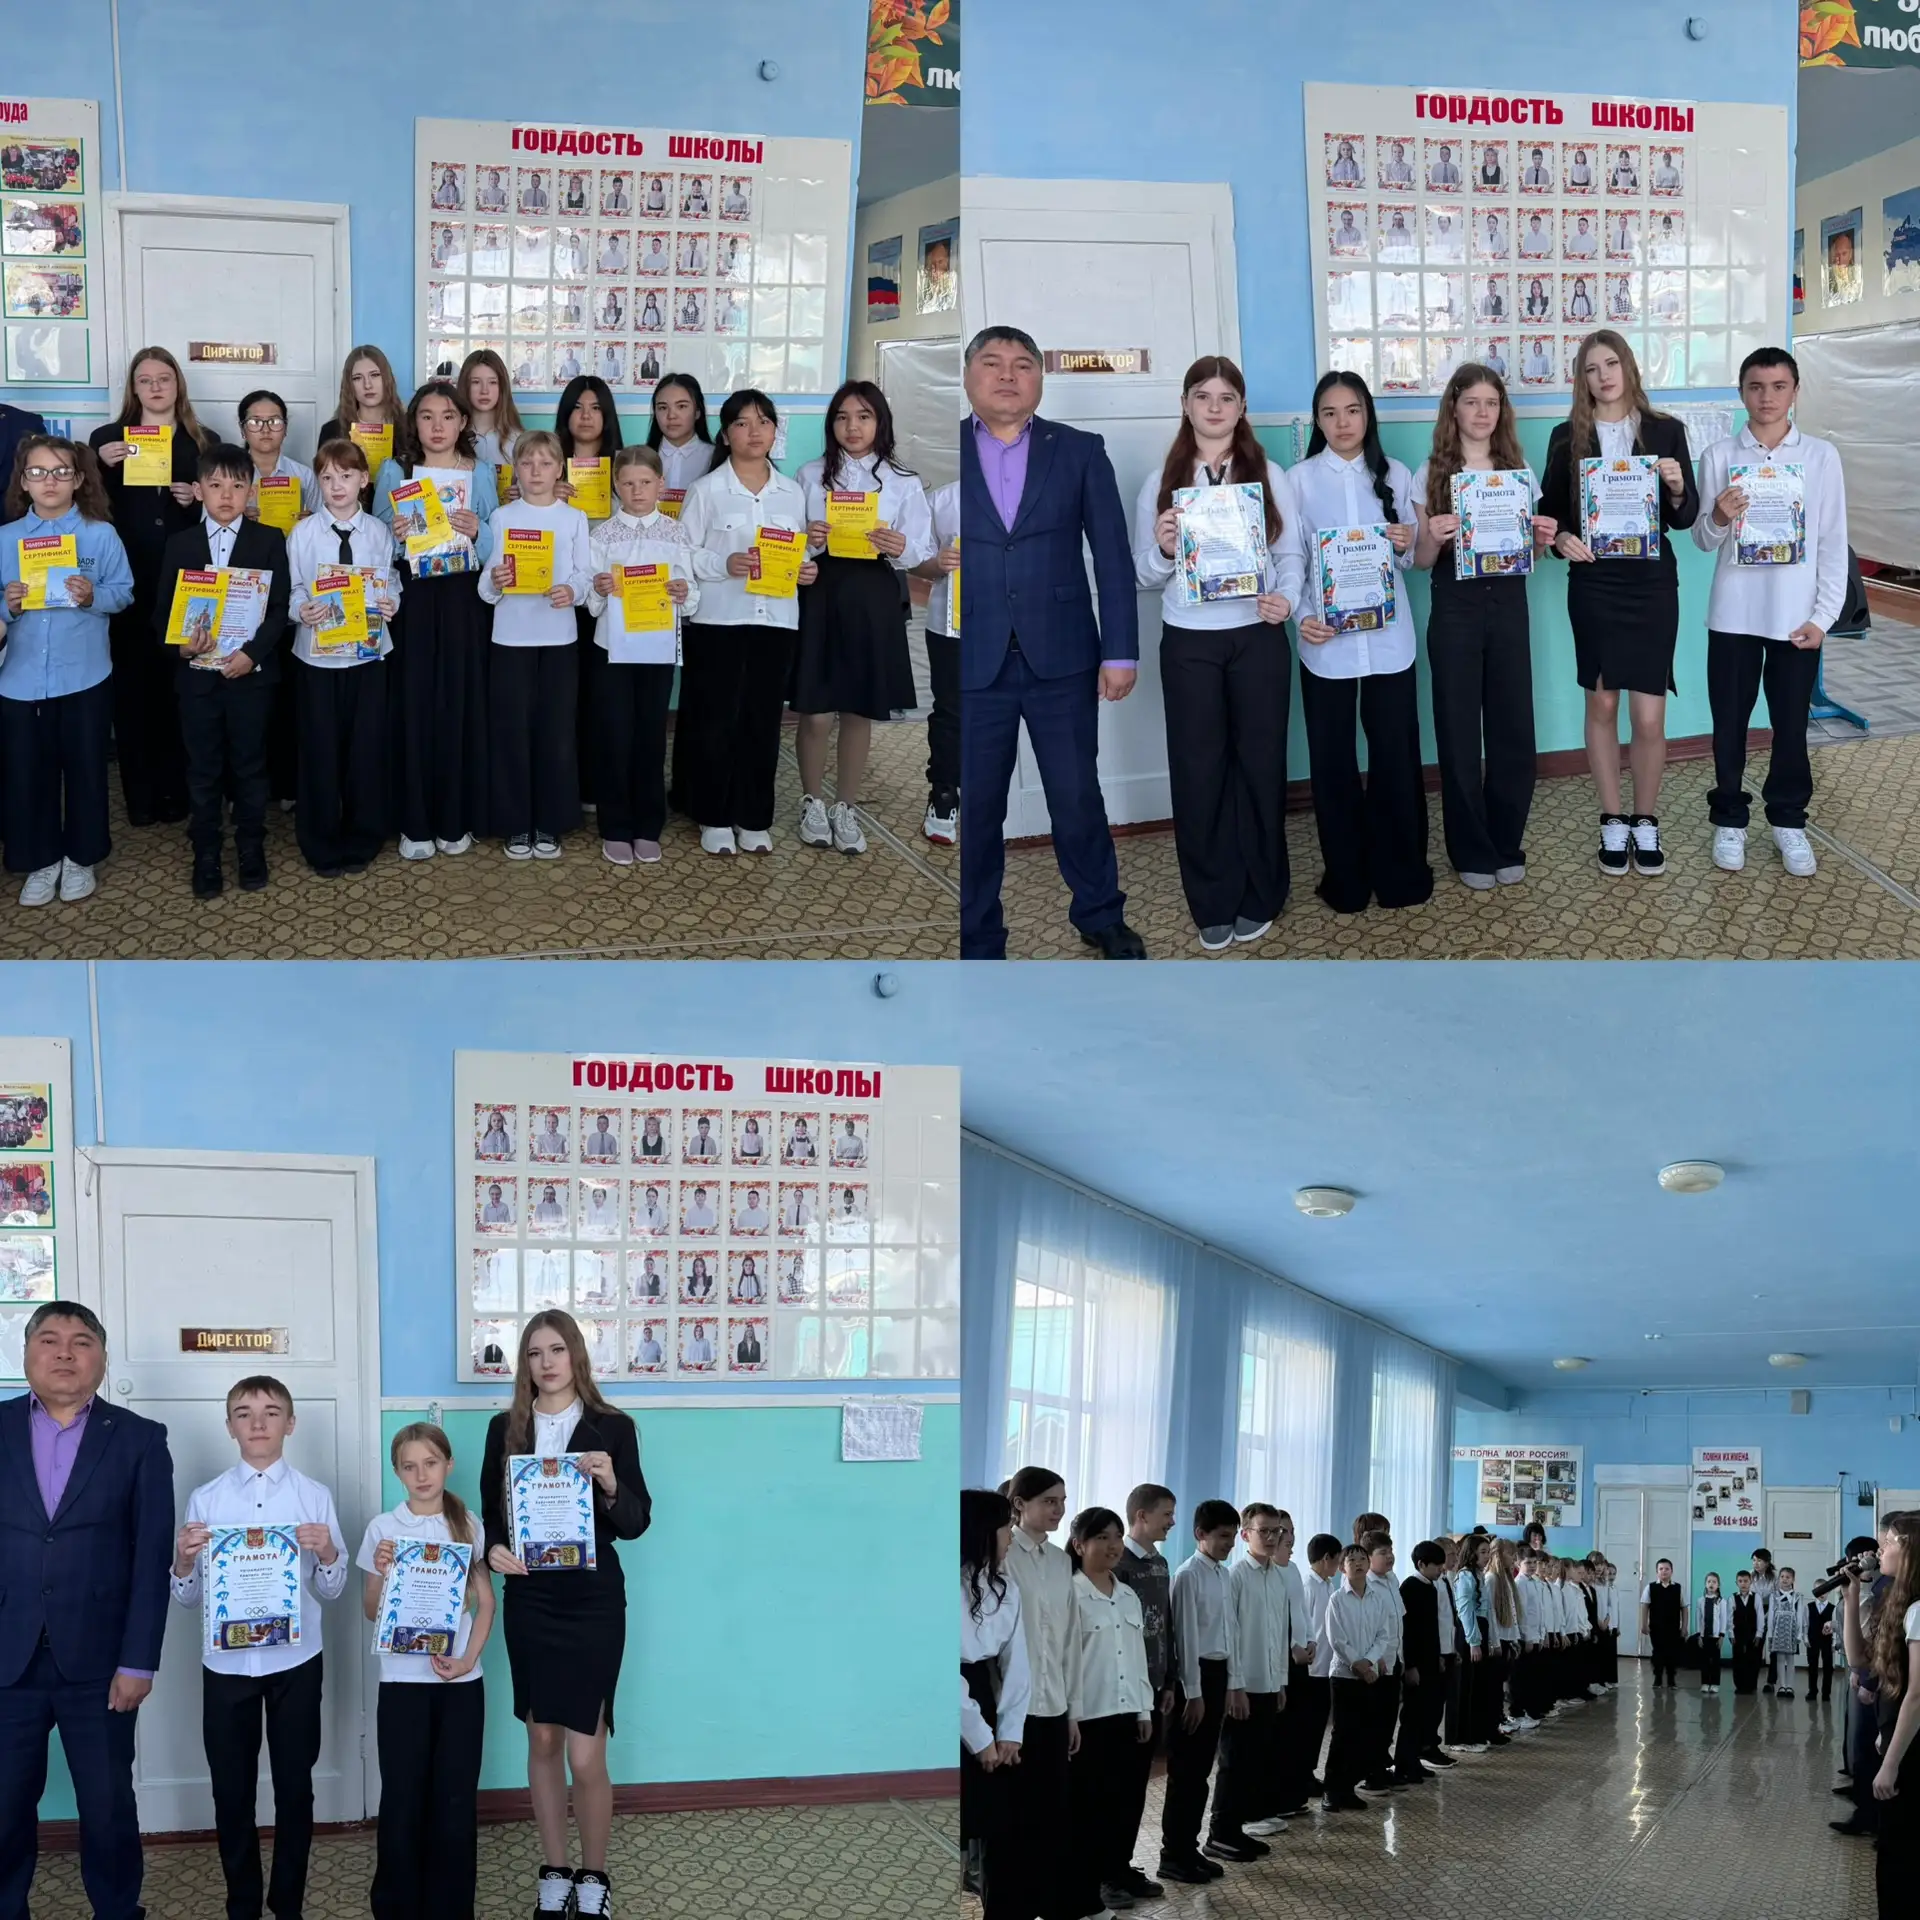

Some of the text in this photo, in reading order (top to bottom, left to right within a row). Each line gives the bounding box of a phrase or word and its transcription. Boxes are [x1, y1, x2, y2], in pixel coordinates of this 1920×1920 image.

[1602, 474, 1643, 485] Грамота
[1475, 489, 1516, 501] Грамота
[507, 543, 549, 551] СЕРТИФИКАТ
[1337, 543, 1377, 555] Грамота
[23, 549, 72, 560] СЕРТИФИКАТ
[180, 585, 223, 595] СЕРТИФИКАТ
[197, 1331, 272, 1348] ДИРЕКТОР
[1470, 1449, 1500, 1458] ПОЛНА
[1505, 1449, 1525, 1458] МОЯ
[1529, 1450, 1569, 1459] РОССИЯ!
[531, 1481, 572, 1490] ГРАМОТА
[1713, 1515, 1758, 1527] 1941 1945
[233, 1552, 278, 1563] ГРАМОТА
[410, 1566, 448, 1576] ГРАМОТА
